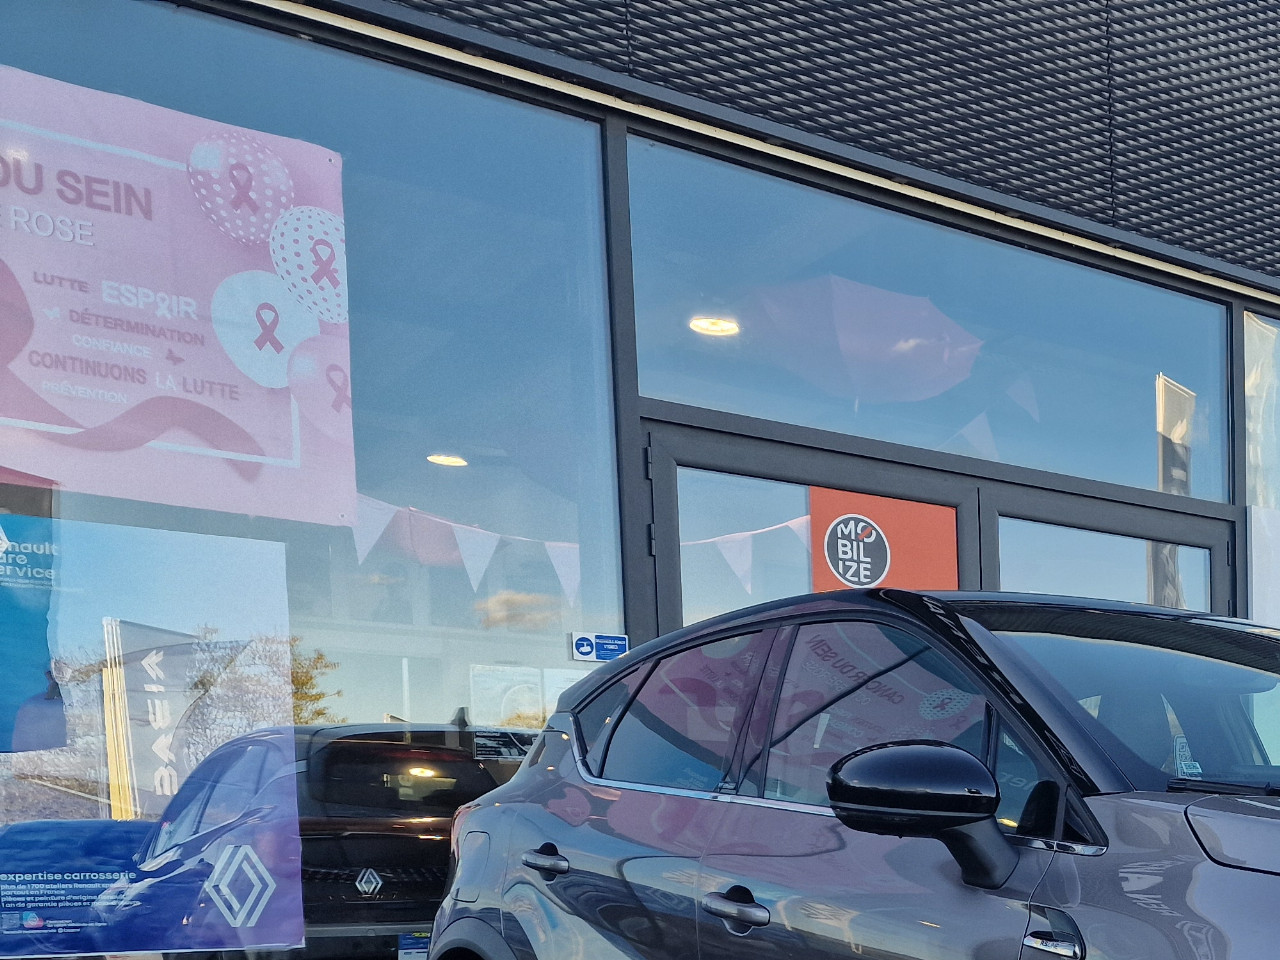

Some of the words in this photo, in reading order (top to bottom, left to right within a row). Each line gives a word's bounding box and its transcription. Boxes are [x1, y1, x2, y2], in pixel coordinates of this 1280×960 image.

[56, 169, 153, 221] SEIN
[10, 206, 95, 246] ROSE
[33, 271, 90, 294] LUTTE
[69, 308, 205, 346] DÉTERMINATION
[72, 334, 152, 359] CONFIANCE
[28, 350, 147, 385] CONTINUONS
[155, 372, 177, 391] LA
[182, 376, 240, 401] LUTTE
[0, 541, 58, 556] nault
[837, 539, 871, 562] BIL
[838, 560, 872, 583] IZE
[0, 871, 62, 882] expertise
[64, 871, 137, 880] carrosserie
